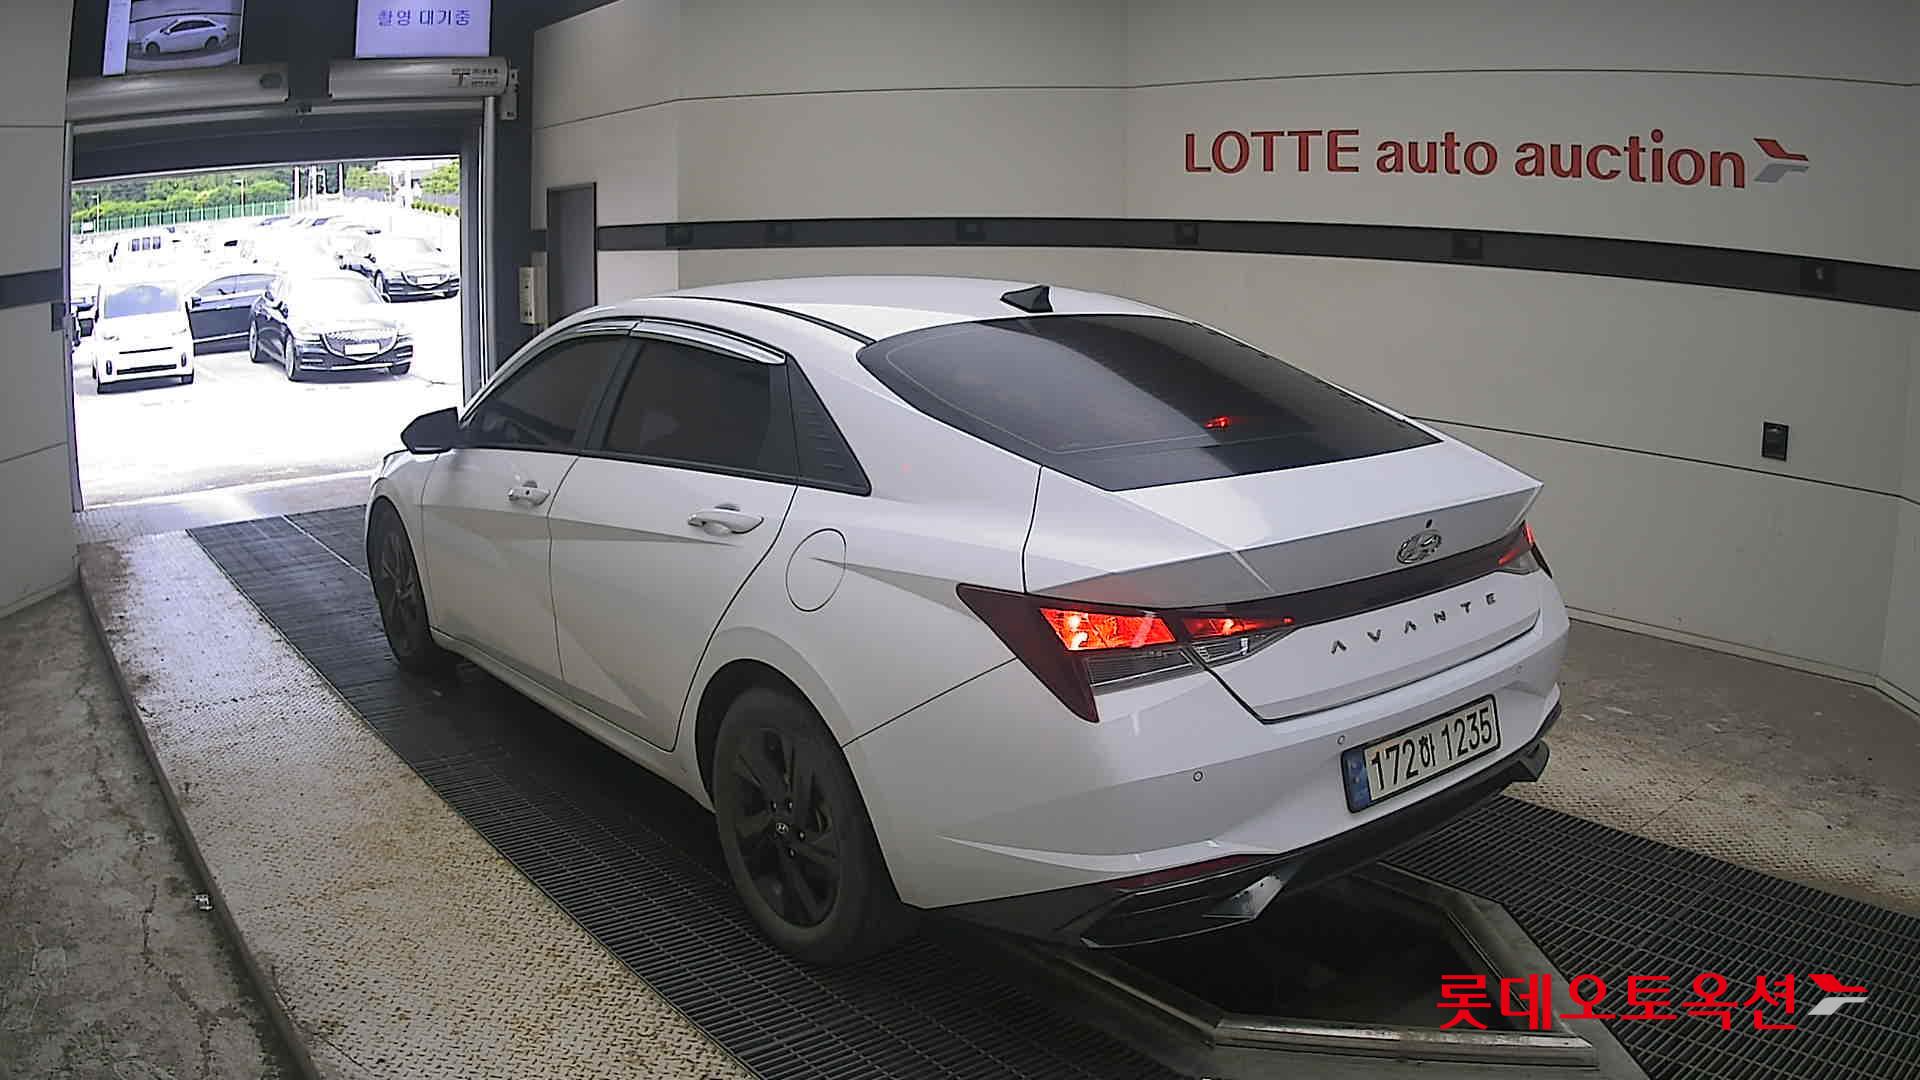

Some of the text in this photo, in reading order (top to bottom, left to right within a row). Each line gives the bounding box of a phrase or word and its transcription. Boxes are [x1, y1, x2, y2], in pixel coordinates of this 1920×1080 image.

[420, 9, 470, 26] 대기중
[1184, 129, 1746, 188] LOTTE auto auction
[1330, 592, 1497, 655] AVANTE
[1370, 706, 1493, 791] 172하 1235
